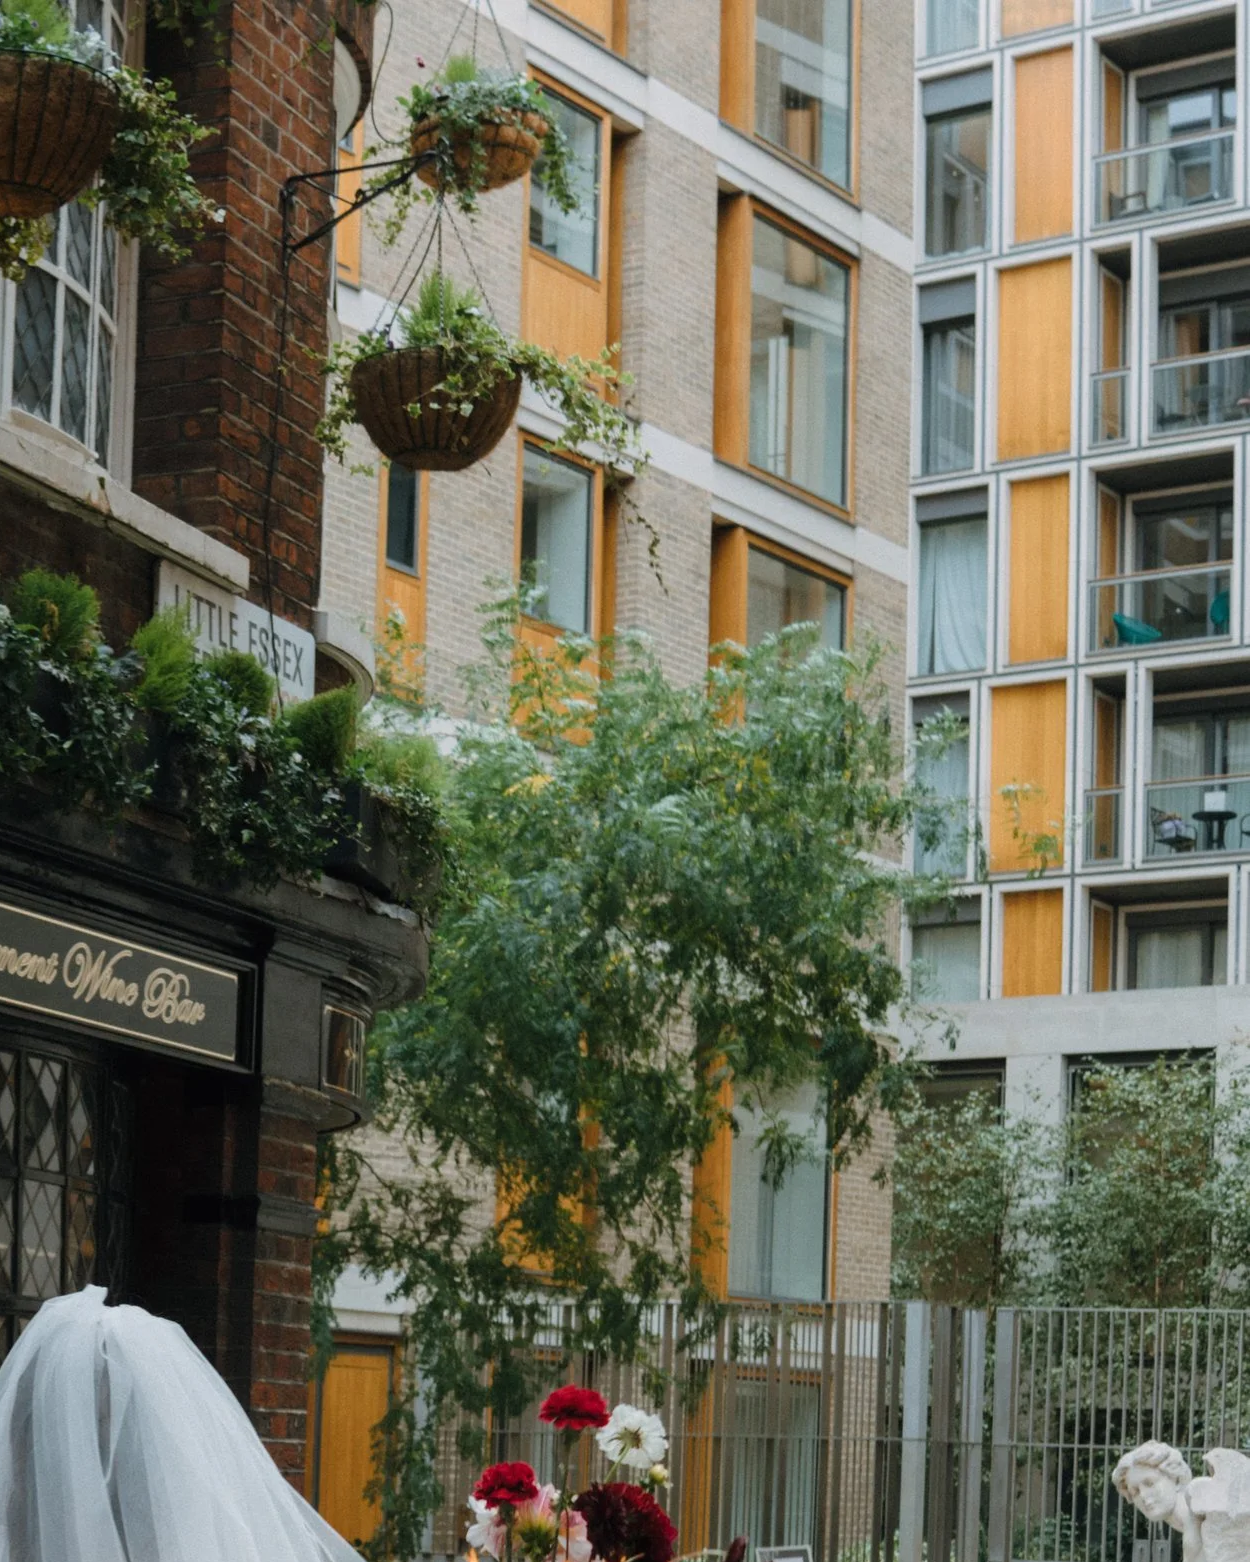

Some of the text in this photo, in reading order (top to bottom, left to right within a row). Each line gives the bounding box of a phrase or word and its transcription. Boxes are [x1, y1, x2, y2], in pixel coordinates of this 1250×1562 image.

[248, 621, 304, 686] ESSEX
[63, 942, 139, 1006] Wine
[142, 967, 206, 1026] Bar
